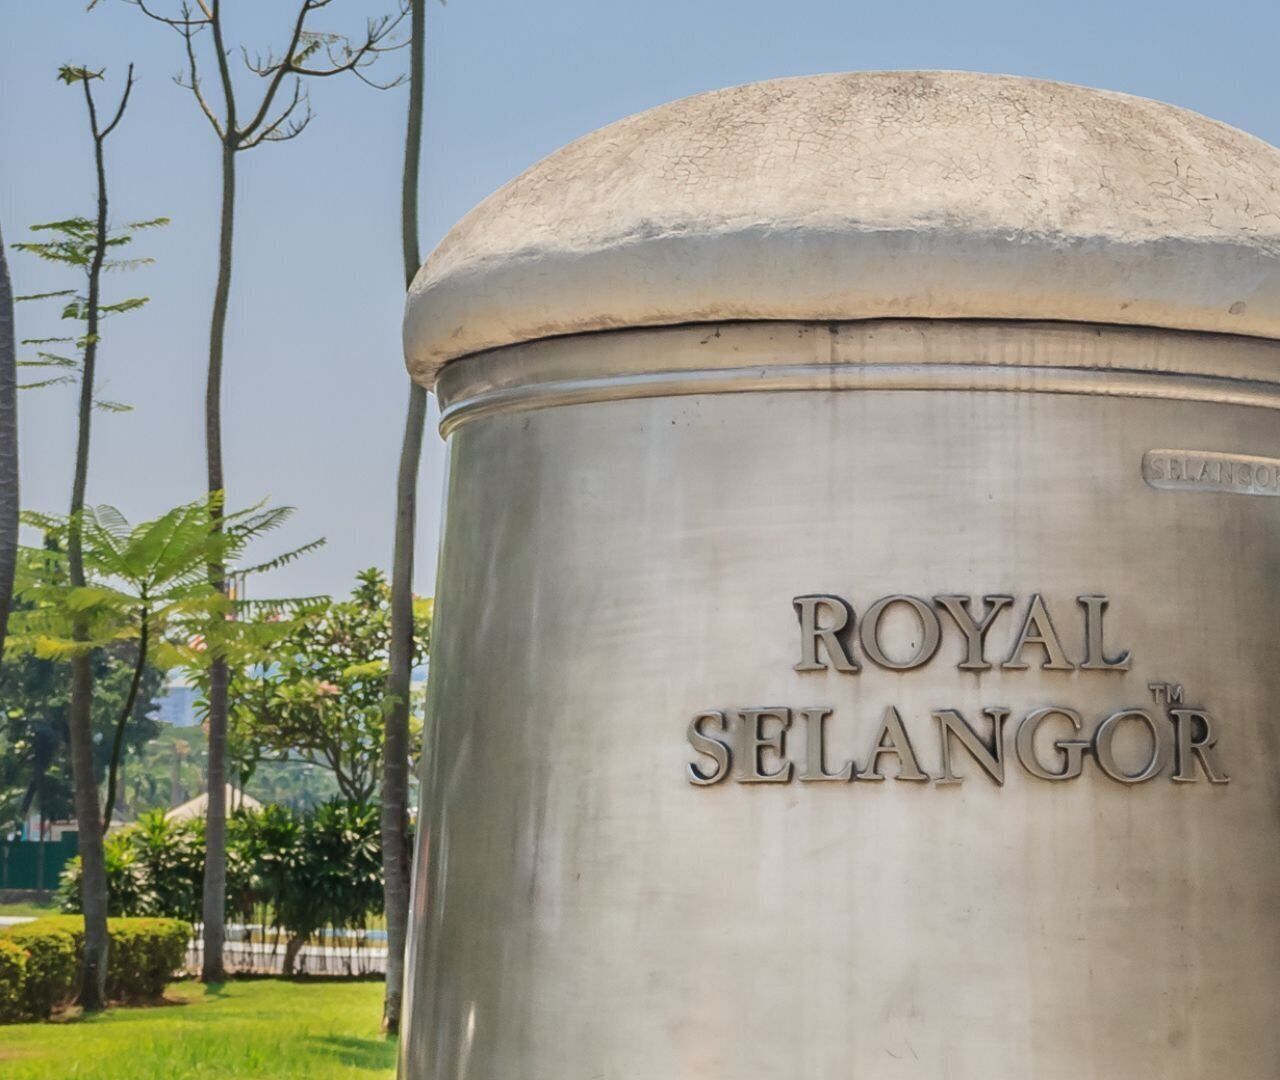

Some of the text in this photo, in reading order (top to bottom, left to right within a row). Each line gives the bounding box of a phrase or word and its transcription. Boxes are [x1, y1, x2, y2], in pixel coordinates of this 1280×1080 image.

[792, 593, 1134, 673] ROYAL
[1149, 682, 1184, 704] TM
[686, 704, 1230, 787] SELANGOR
